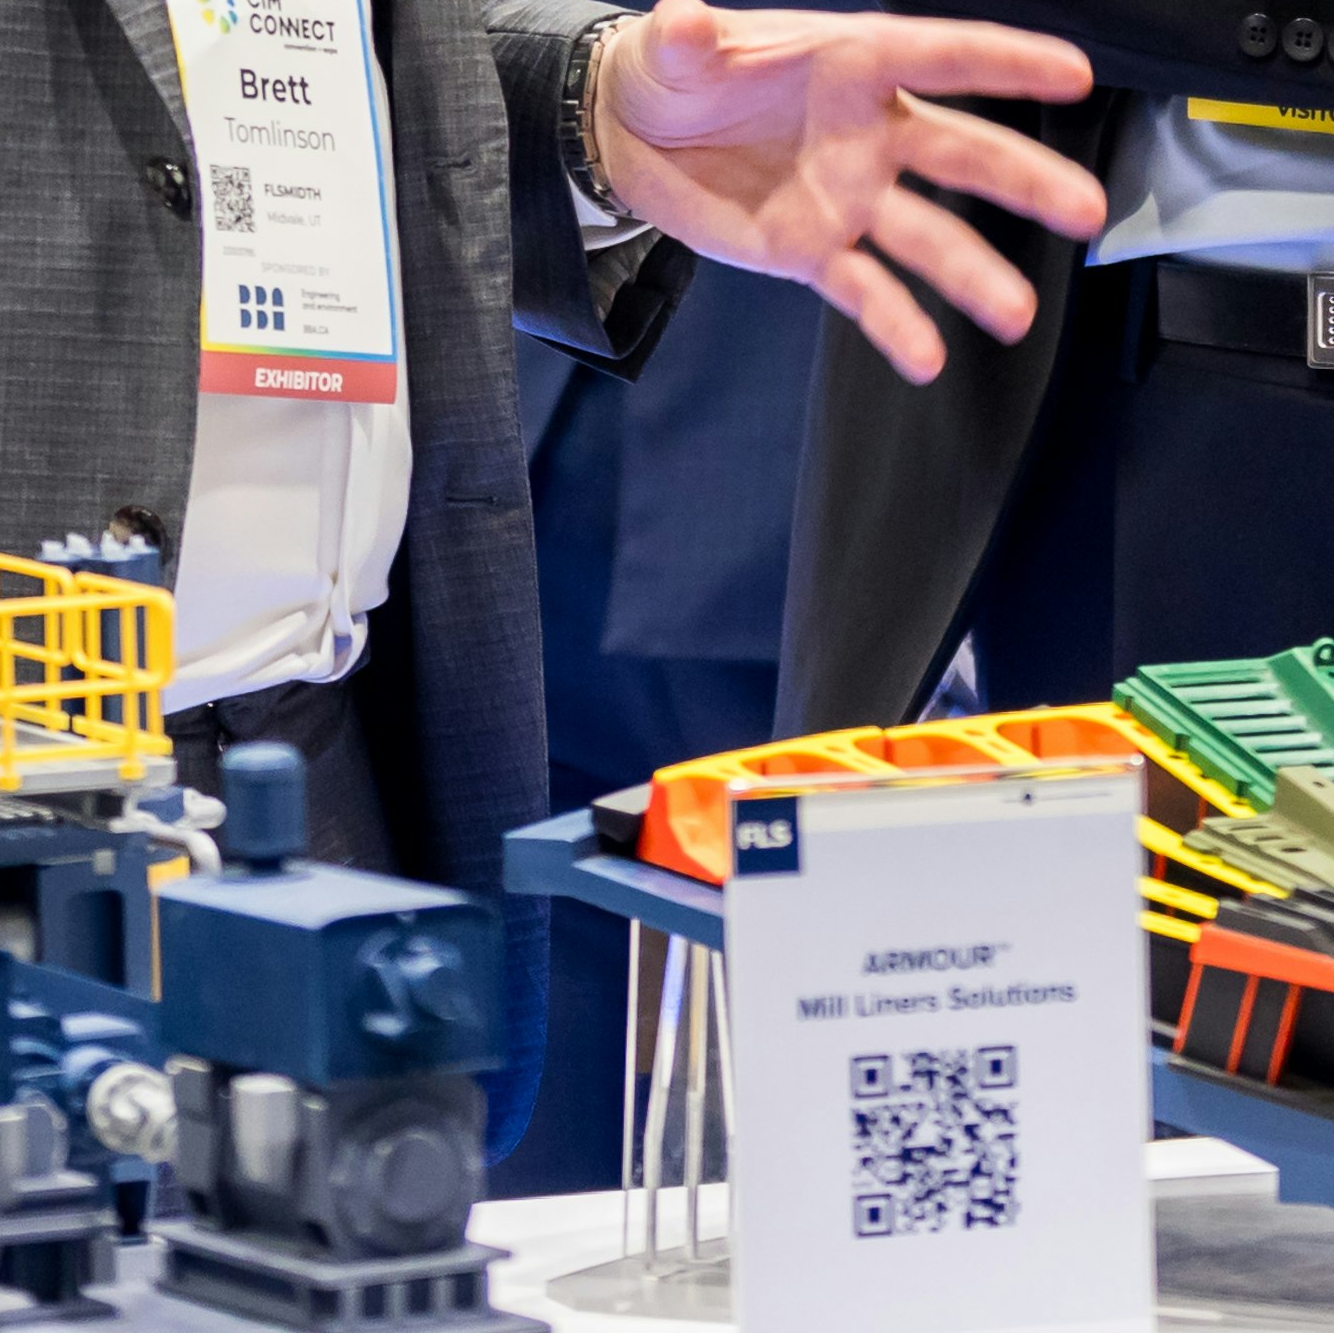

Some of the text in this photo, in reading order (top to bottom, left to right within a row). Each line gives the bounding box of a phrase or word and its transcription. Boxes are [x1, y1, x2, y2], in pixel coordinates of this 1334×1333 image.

[250, 13, 336, 42] CONNECT
[240, 68, 312, 106] Brett
[223, 116, 336, 152] Tomlinson
[264, 183, 322, 201] FLSMIDTH
[254, 367, 344, 392] EXHIBITOR
[737, 819, 793, 851] FLS
[797, 982, 1078, 1021] Mill Liners Solutions
